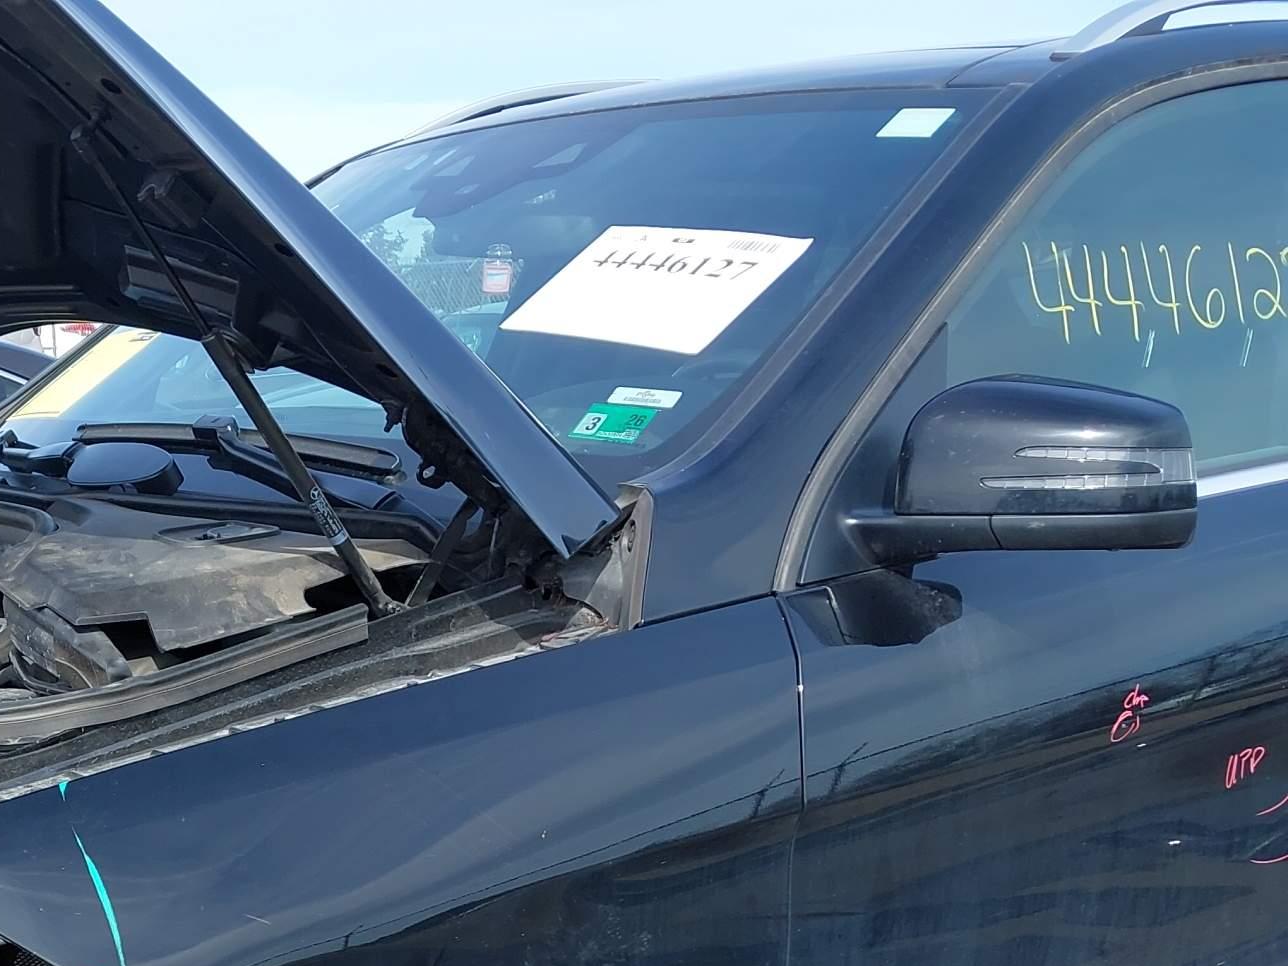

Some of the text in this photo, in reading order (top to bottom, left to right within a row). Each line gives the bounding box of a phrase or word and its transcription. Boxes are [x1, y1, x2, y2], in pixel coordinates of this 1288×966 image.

[593, 250, 759, 280] 44446127
[1021, 241, 1288, 344] 4444612
[585, 416, 601, 431] 3
[624, 414, 647, 427] 26
